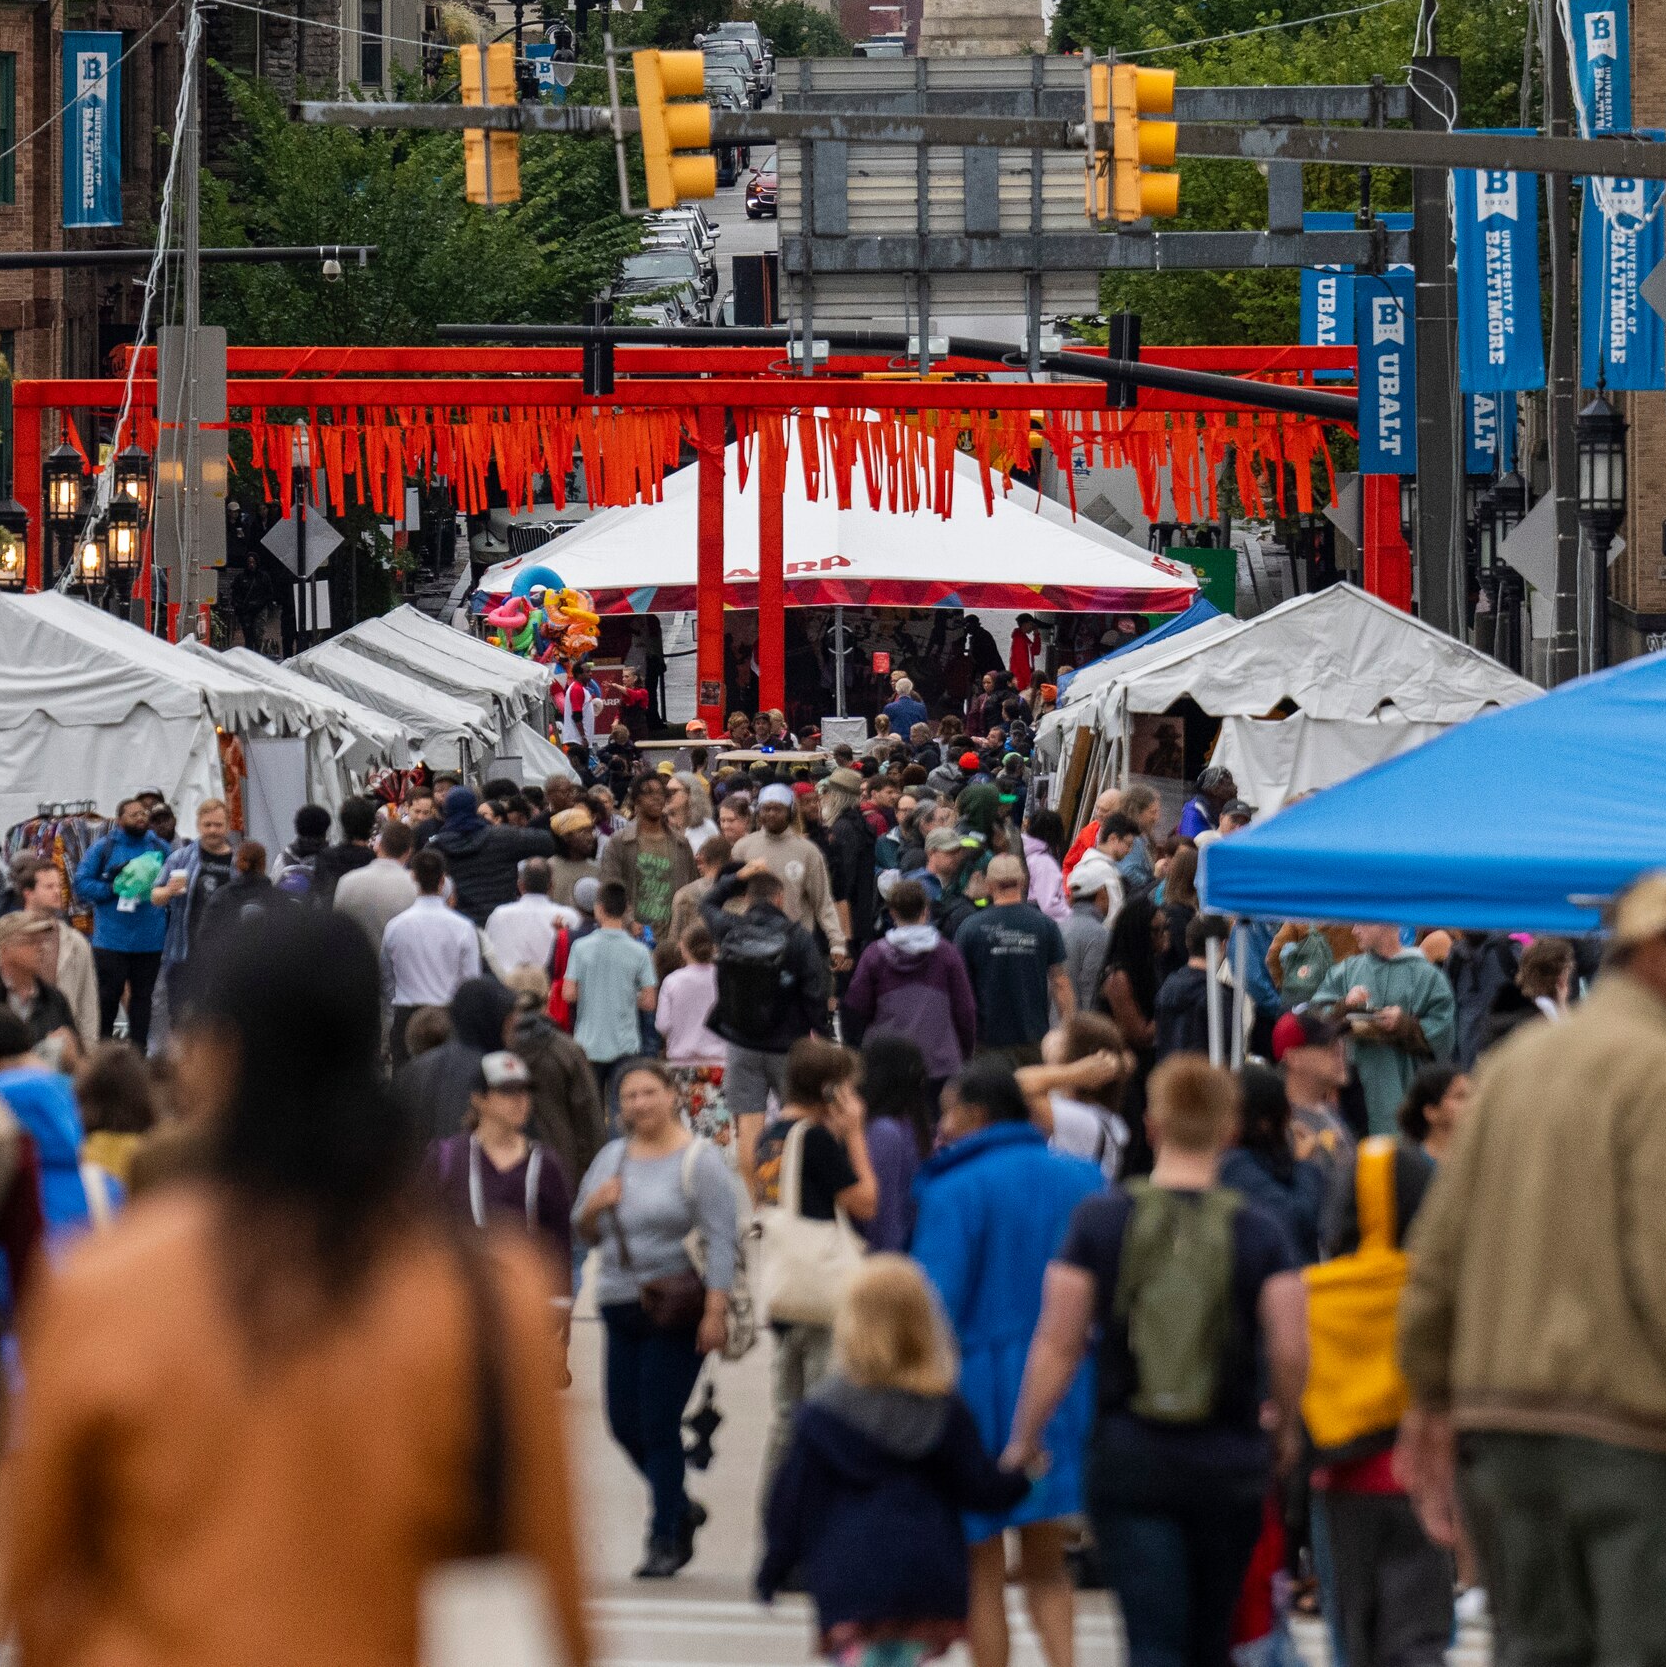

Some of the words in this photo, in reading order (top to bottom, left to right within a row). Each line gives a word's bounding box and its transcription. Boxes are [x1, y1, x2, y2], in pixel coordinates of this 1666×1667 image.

[1591, 18, 1611, 41] B
[83, 57, 102, 80] B
[1604, 66, 1613, 129] UNIVERSITY
[1594, 67, 1605, 131] BALTIM
[83, 108, 95, 209] BALTIMORE
[94, 108, 102, 168] UNIVERSITY
[95, 172, 102, 186] OF
[1484, 170, 1509, 195] B
[1484, 199, 1510, 207] 1925
[1485, 230, 1505, 365] BALTIMORE
[1501, 230, 1514, 312] UNIVERSITY
[1611, 230, 1627, 364] BALTIMORE
[1626, 230, 1638, 312] UNIVERSITY
[1317, 277, 1337, 346] UBAL
[1378, 304, 1398, 325] B
[1504, 316, 1515, 335] OF
[1627, 316, 1637, 334] OF
[1378, 352, 1402, 456] UBALT
[1474, 393, 1496, 454] ALT
[724, 554, 852, 579] ARP
[602, 698, 621, 706] ARP
